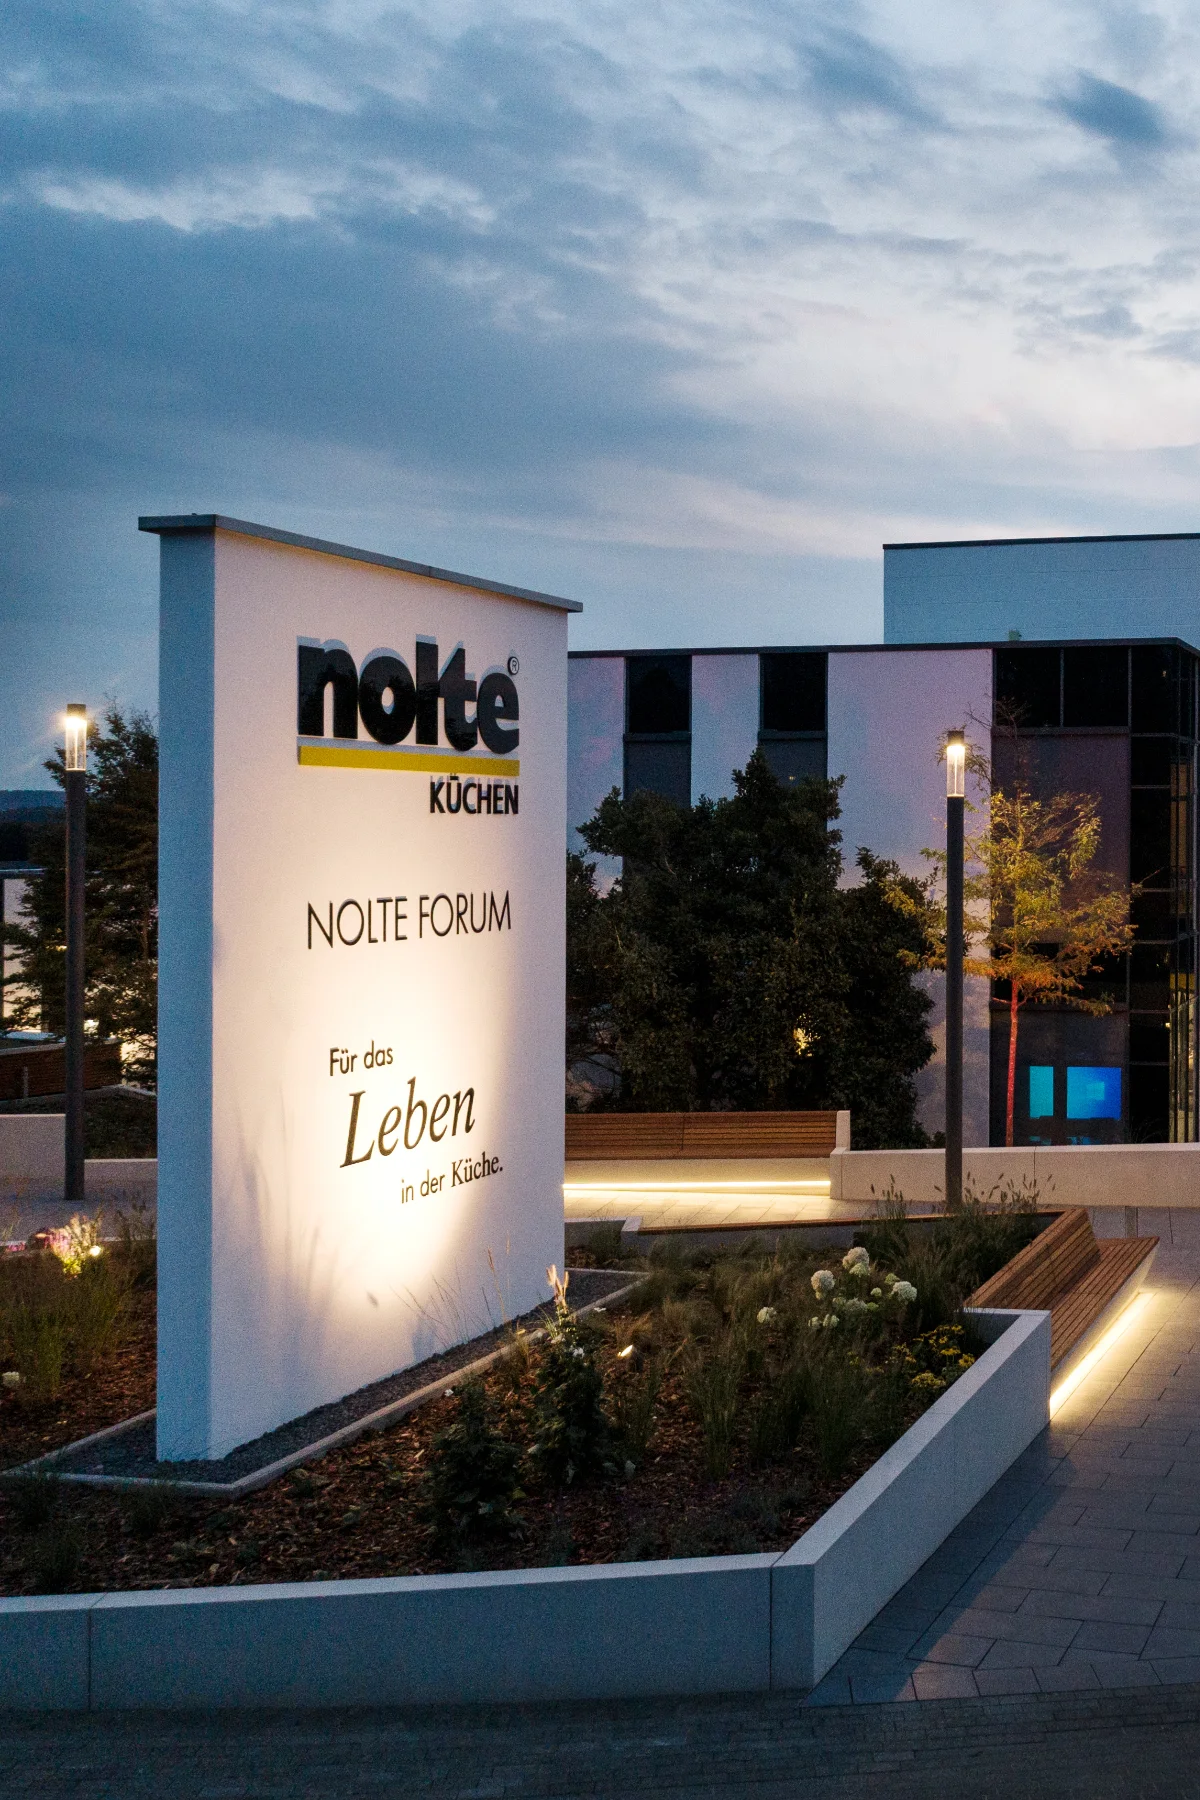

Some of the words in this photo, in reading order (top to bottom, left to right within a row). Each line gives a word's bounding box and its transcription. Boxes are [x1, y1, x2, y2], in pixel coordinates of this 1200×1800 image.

[430, 773, 518, 814] KÜCHEN
[308, 897, 408, 949] NOLTE
[420, 890, 511, 938] FORUM
[330, 1047, 358, 1076] Für
[364, 1040, 393, 1069] das
[340, 1076, 475, 1168] Leben
[401, 1179, 415, 1204] in
[420, 1169, 446, 1197] der
[451, 1151, 503, 1187] Küche.
